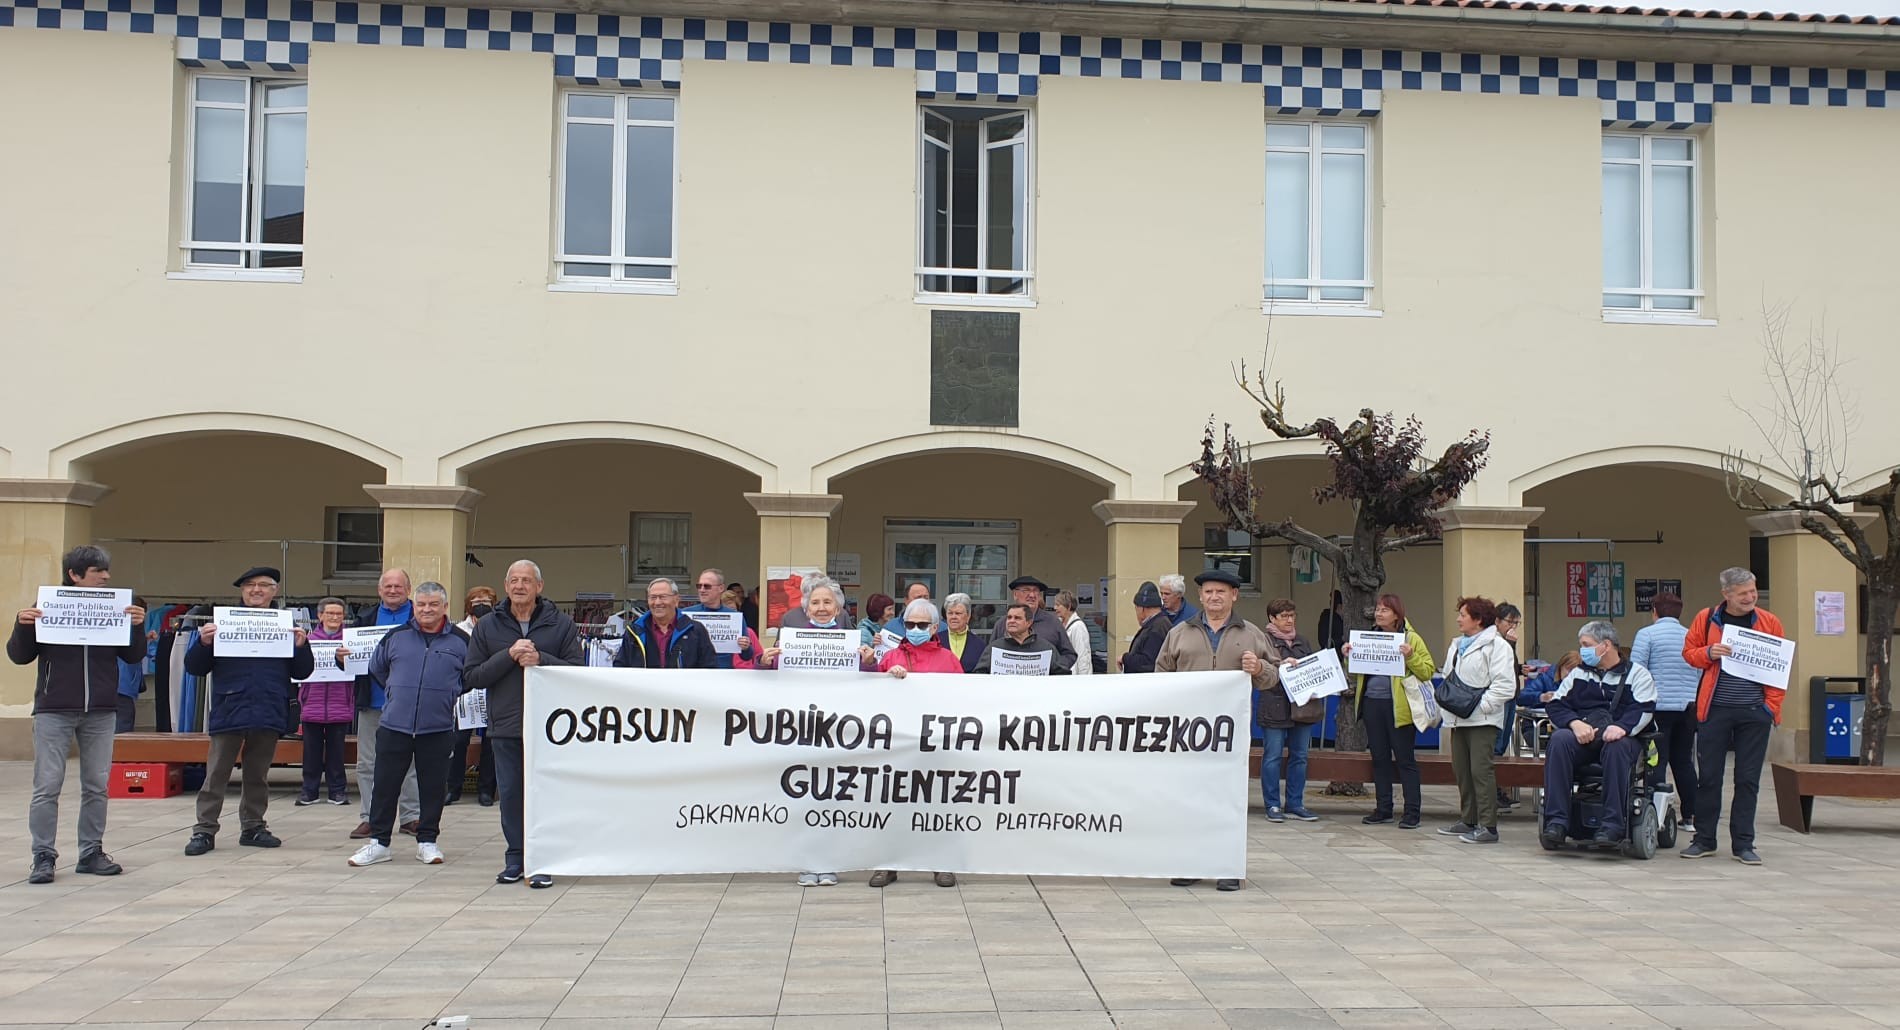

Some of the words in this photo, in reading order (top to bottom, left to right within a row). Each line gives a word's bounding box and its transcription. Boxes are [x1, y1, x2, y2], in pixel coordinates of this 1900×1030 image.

[78, 602, 114, 610] Publikoa
[78, 610, 126, 618] kalitatezkoa
[41, 616, 124, 626] GUZTIENTZAT!
[219, 632, 288, 640] GUZTIENTZAT!
[1726, 638, 1751, 648] Osasun
[1752, 644, 1779, 656] Publikoa
[784, 657, 854, 666] GUZTIENTZAT!
[1352, 653, 1400, 662] GUZTIENTZAT!
[1730, 652, 1785, 672] UZTIENTZAT!
[545, 706, 697, 746] OSASUN
[920, 714, 984, 752] ETA
[676, 803, 789, 829] SAKANAKO
[805, 810, 892, 830] OSASUN
[911, 812, 982, 832] ALDEKO
[996, 812, 1123, 833] PLATAFORMA
